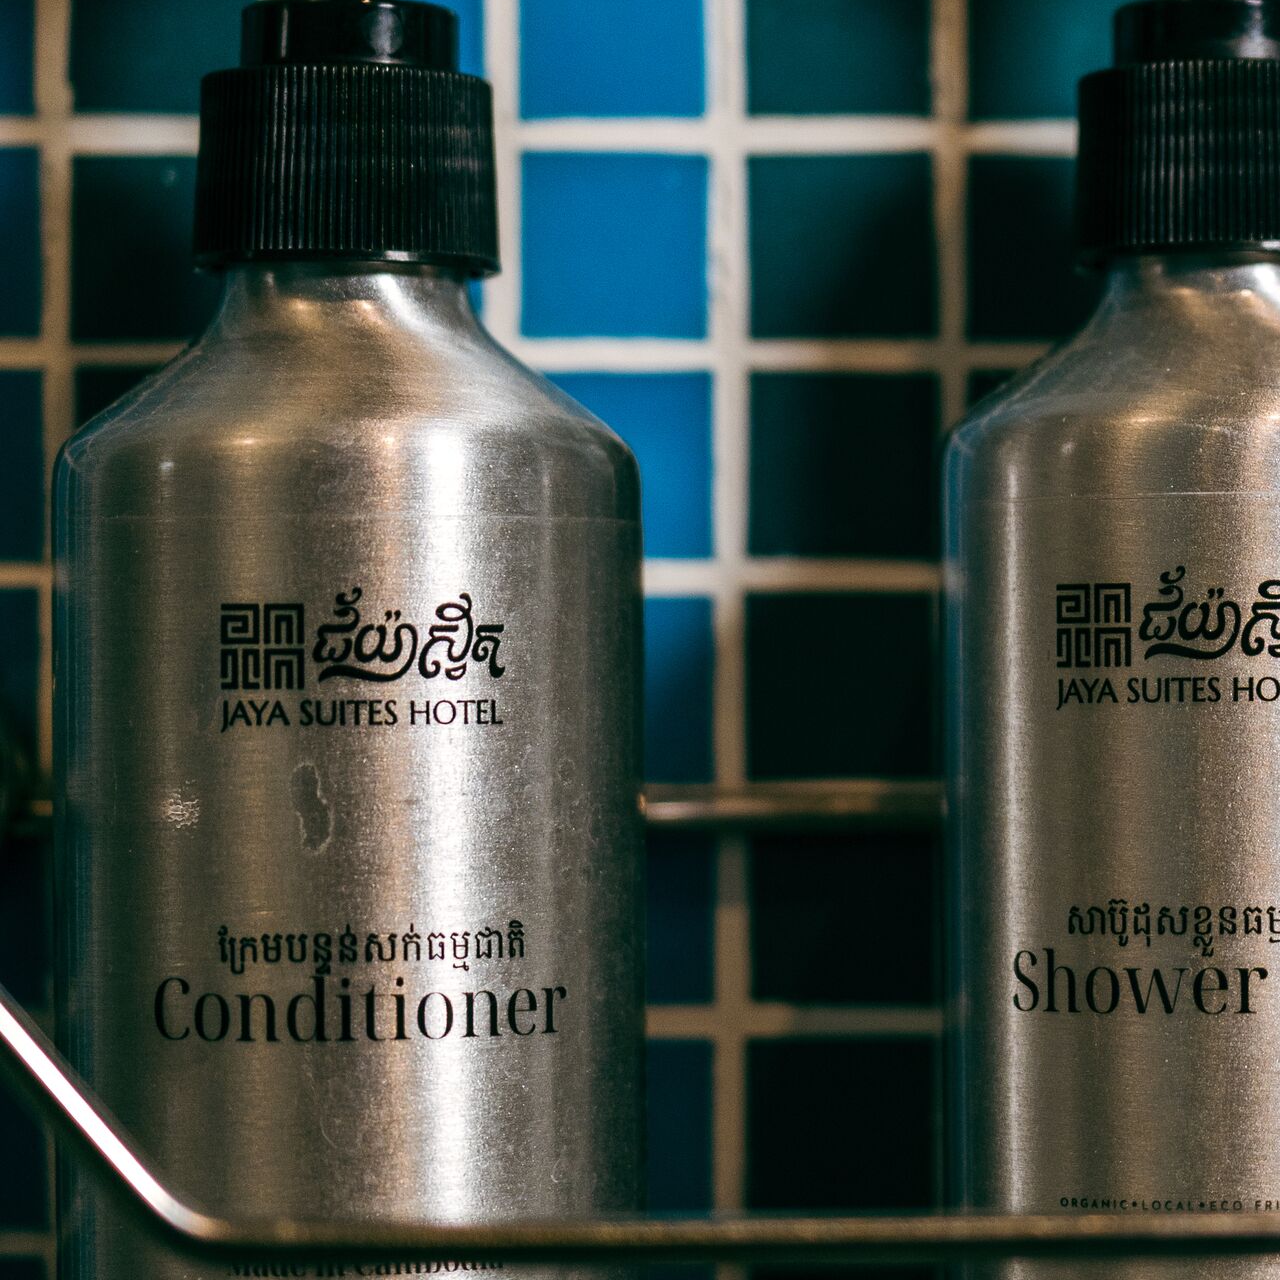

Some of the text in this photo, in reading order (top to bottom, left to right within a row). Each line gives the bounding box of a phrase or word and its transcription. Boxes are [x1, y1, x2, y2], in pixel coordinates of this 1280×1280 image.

[221, 698, 504, 733] JAYA SUITES HOTEL
[1057, 678, 1118, 710] JAYA
[1127, 677, 1221, 704] SUITES
[1012, 947, 1269, 1015] Shower
[154, 975, 568, 1043] Conditioner
